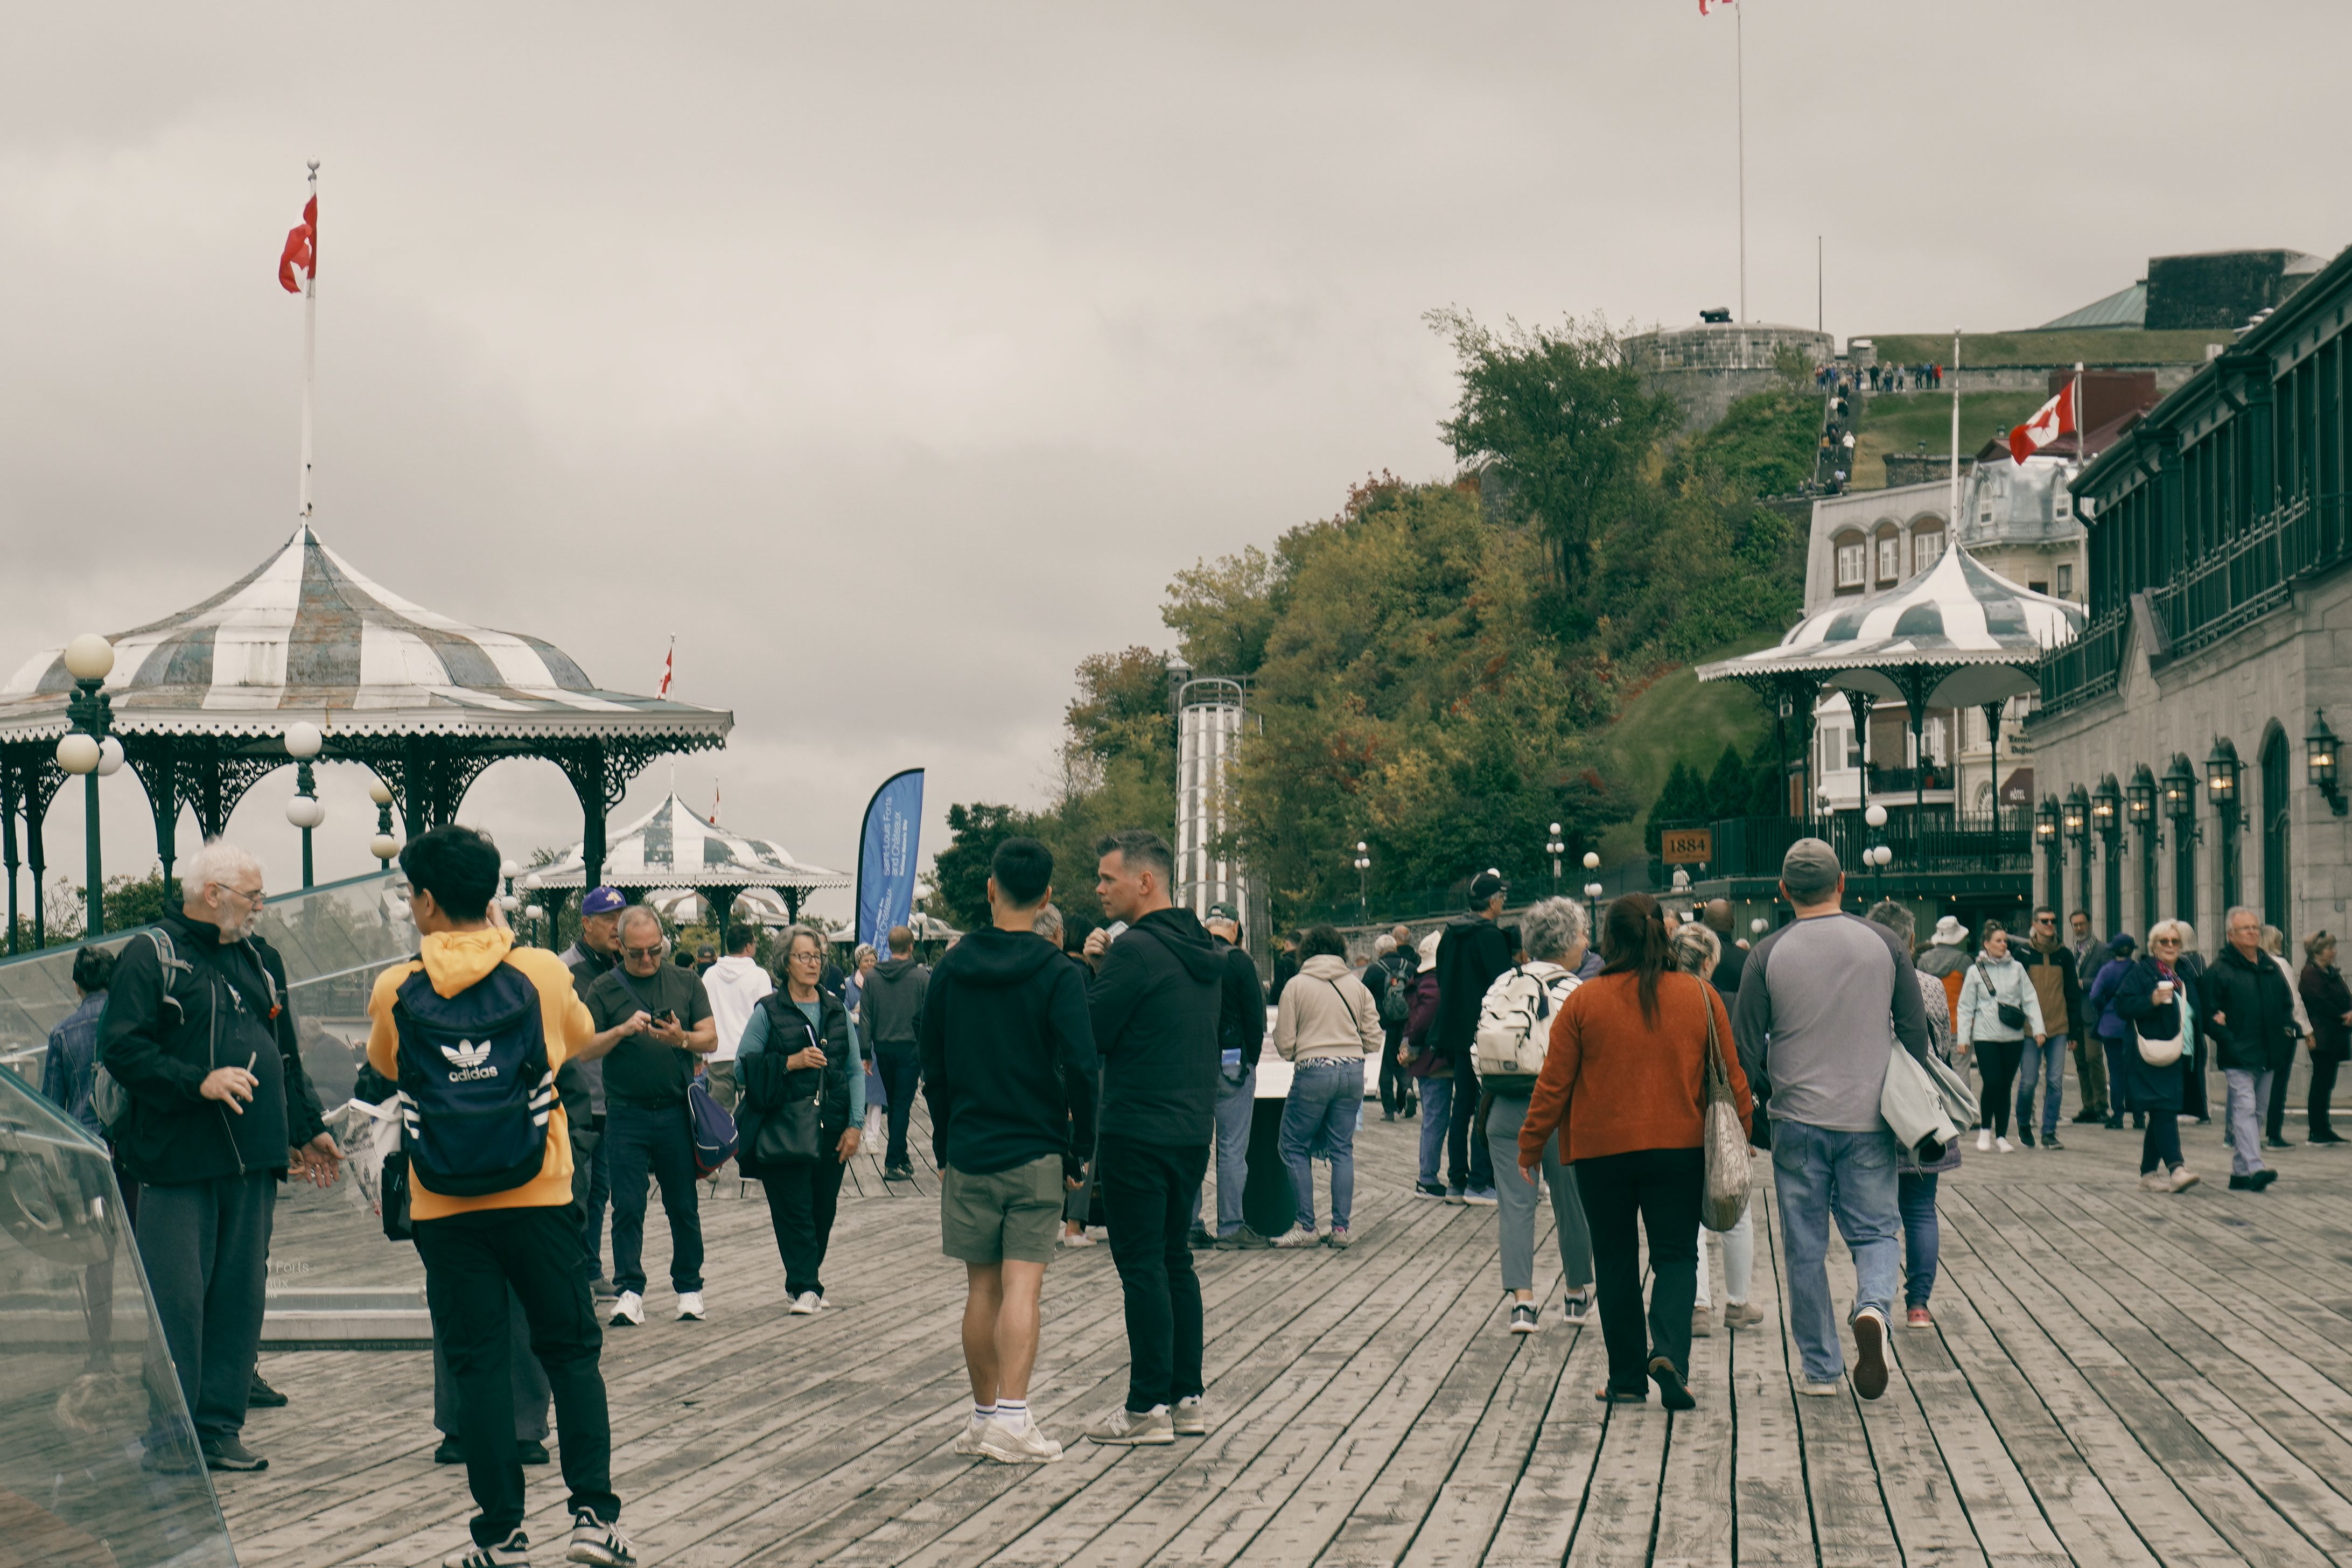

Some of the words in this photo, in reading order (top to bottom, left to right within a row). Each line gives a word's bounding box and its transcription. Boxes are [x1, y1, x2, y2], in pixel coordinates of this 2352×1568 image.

[2010, 787, 2026, 801] HÔTEL
[883, 796, 892, 822] Forts
[891, 811, 901, 857] Châteaux
[882, 823, 891, 877] Saint-Louis
[1670, 838, 1706, 853] 1884
[449, 1065, 499, 1083] adidas
[276, 1260, 310, 1274] Forts
